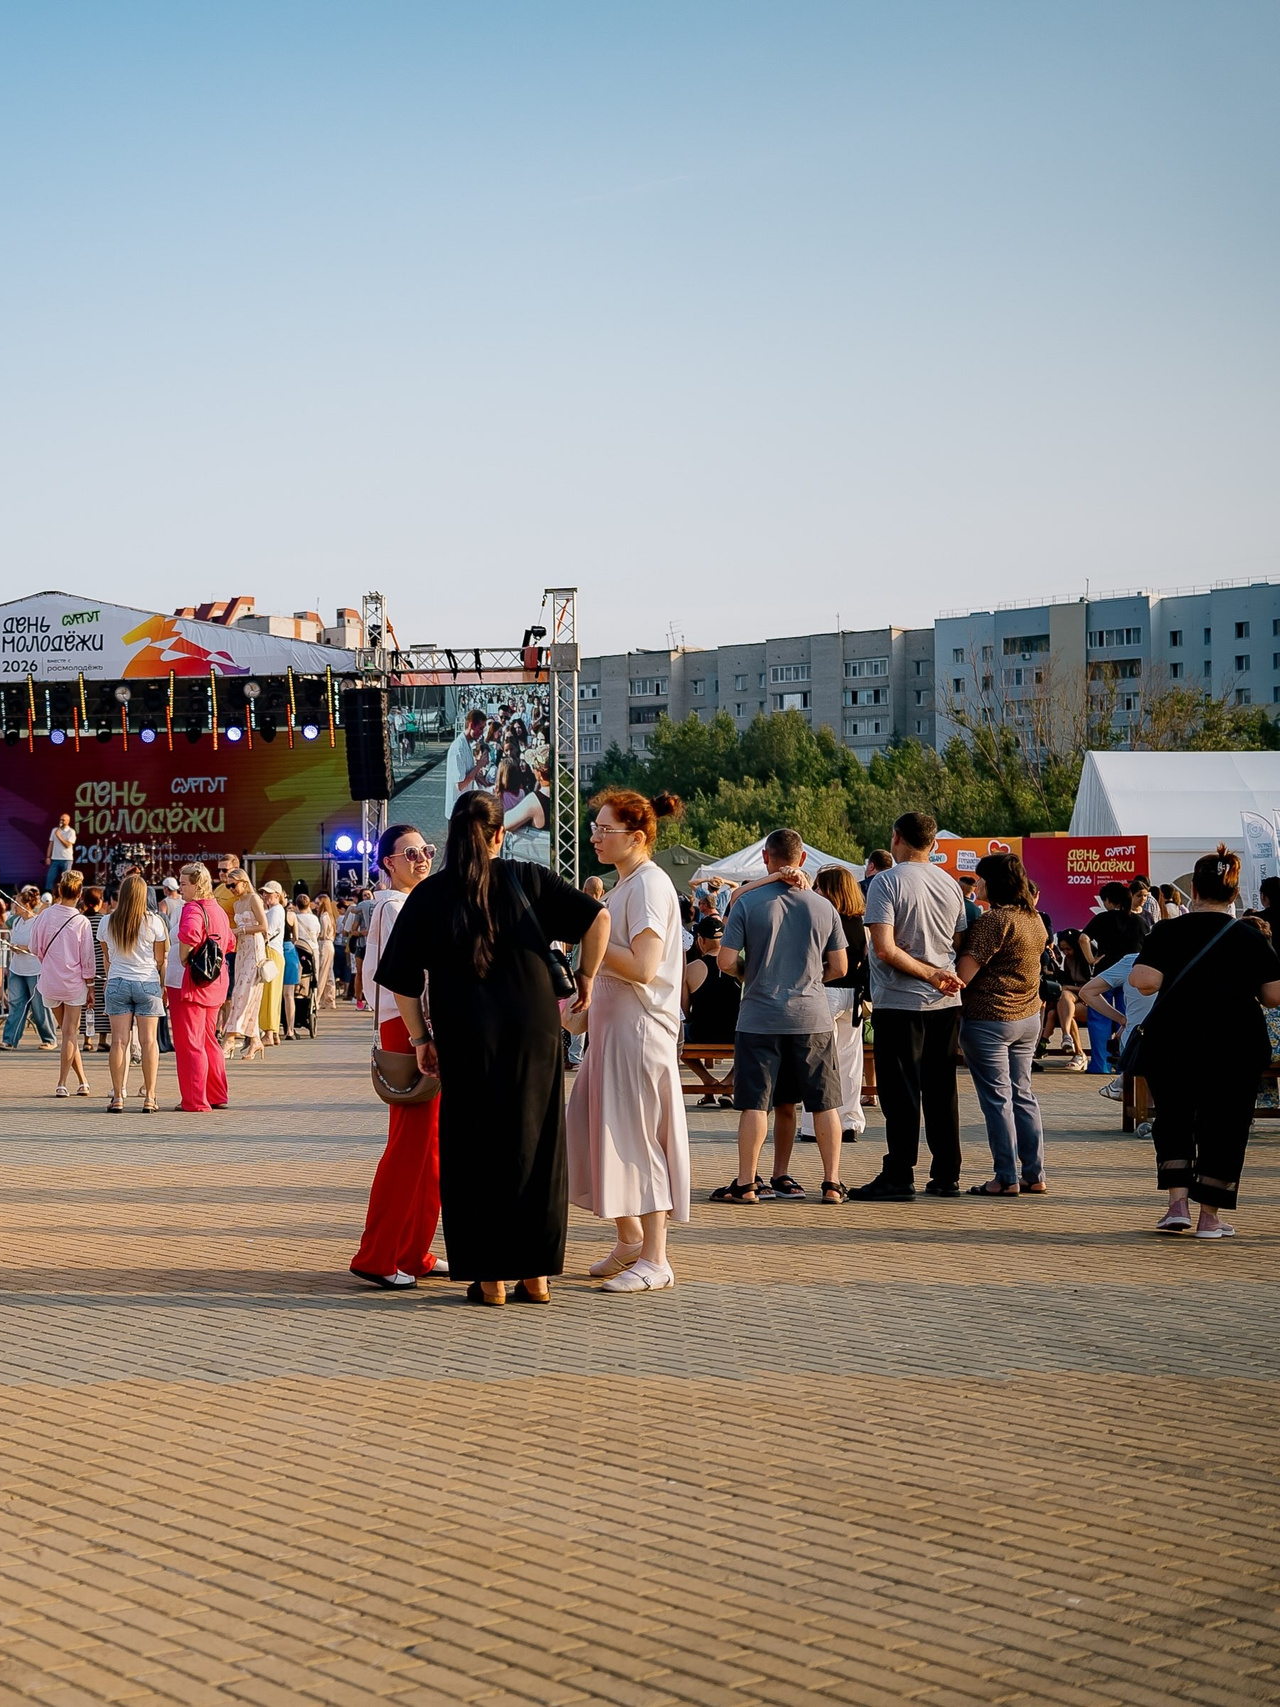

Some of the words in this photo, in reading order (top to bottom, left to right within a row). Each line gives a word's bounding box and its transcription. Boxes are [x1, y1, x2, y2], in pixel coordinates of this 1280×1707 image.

[61, 610, 100, 626] СУРГУТ
[2, 660, 38, 673] 2026
[47, 665, 104, 674] росмолодёжь
[171, 777, 227, 793] СУРГУТ
[1105, 845, 1136, 857] СУРГУТ
[1067, 875, 1092, 884] 2026
